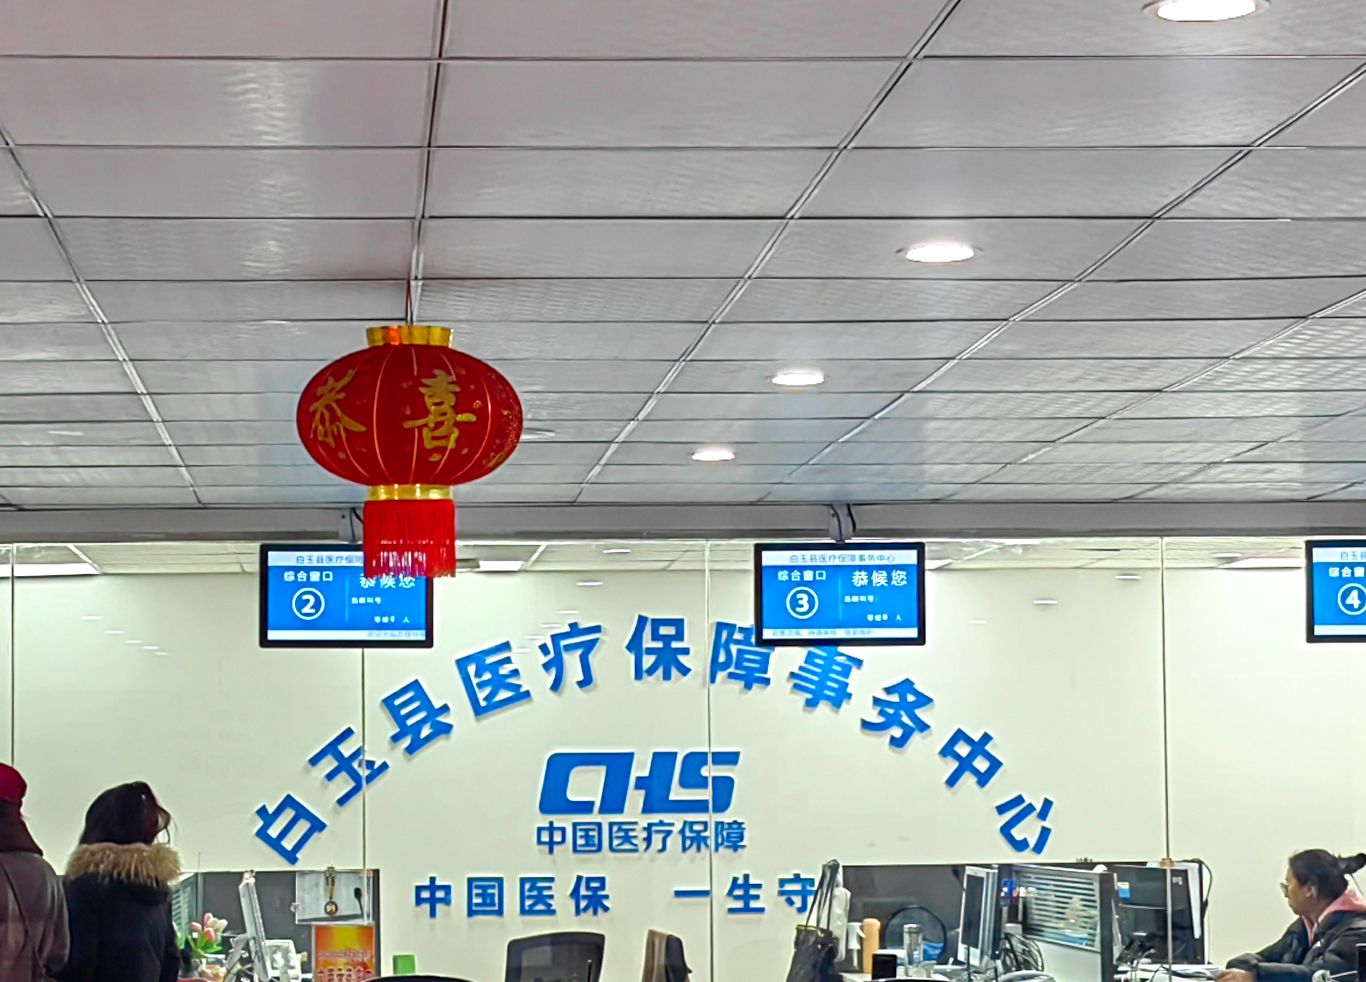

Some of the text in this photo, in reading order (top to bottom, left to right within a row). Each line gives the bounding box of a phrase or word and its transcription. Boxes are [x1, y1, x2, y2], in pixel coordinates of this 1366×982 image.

[284, 571, 333, 582] 综合窗口
[777, 570, 826, 581] 综合窗口
[852, 570, 907, 587] 恭候您
[254, 613, 1057, 866] 白玉县医疗保障事务中心
[537, 751, 743, 816] CHS
[535, 820, 748, 855] 中国医疗保障
[414, 872, 818, 919] 中国医保 一生守
